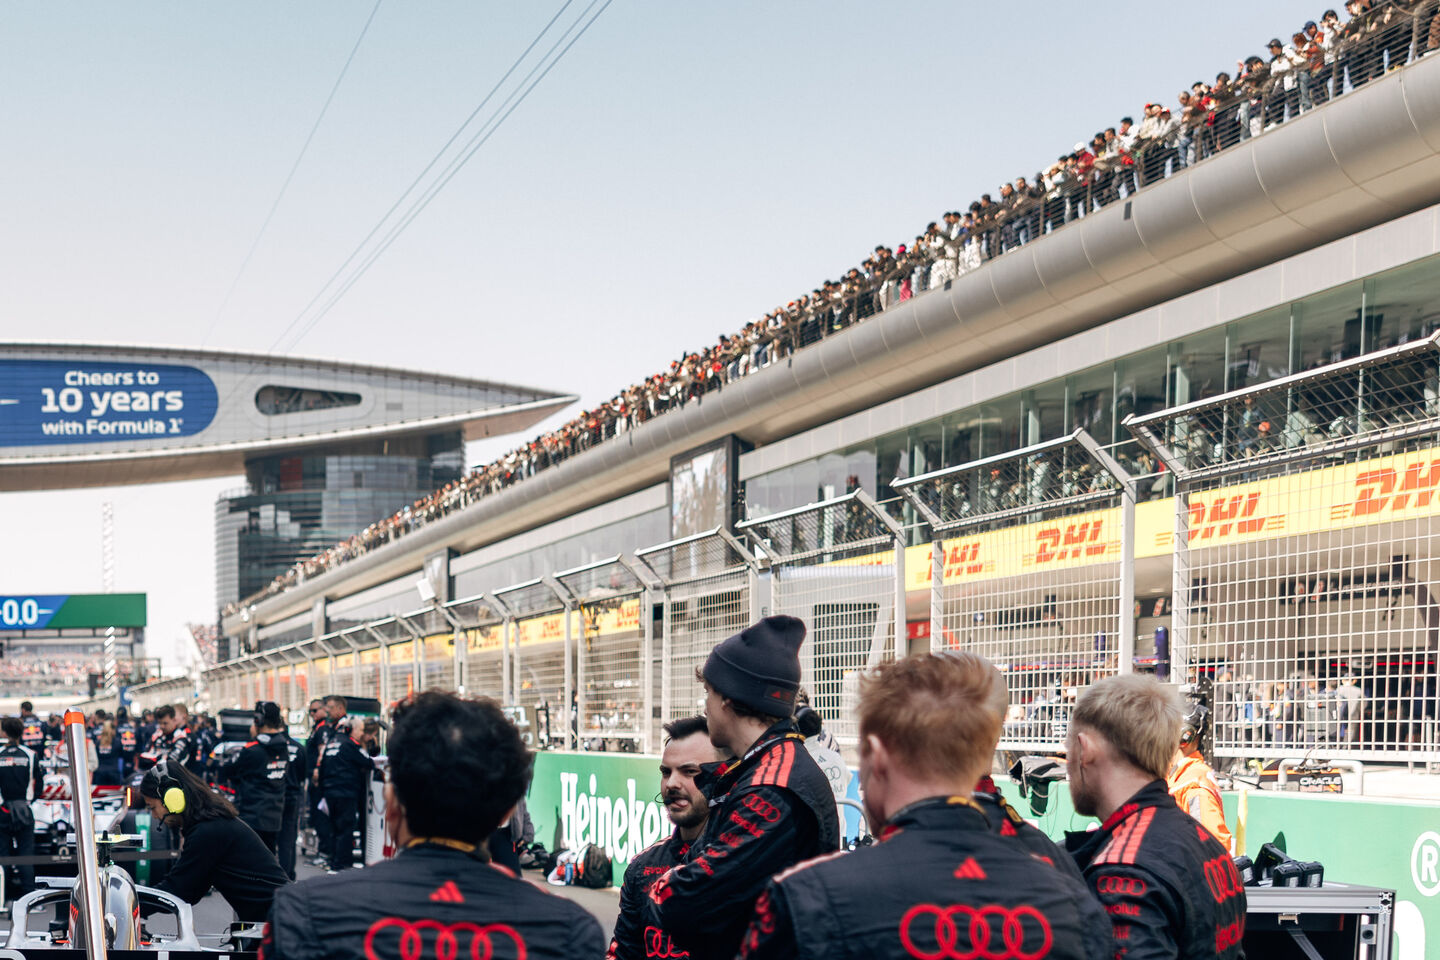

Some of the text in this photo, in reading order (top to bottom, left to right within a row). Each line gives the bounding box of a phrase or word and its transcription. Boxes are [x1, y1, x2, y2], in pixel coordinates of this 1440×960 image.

[64, 370, 160, 386] Cheers to
[41, 387, 184, 416] 10 years
[41, 421, 84, 436] with
[86, 419, 166, 435] Formula
[1353, 464, 1440, 516] DH
[1184, 492, 1269, 539] DHL
[1035, 520, 1108, 564] DHL
[2, 599, 39, 626] 0.0
